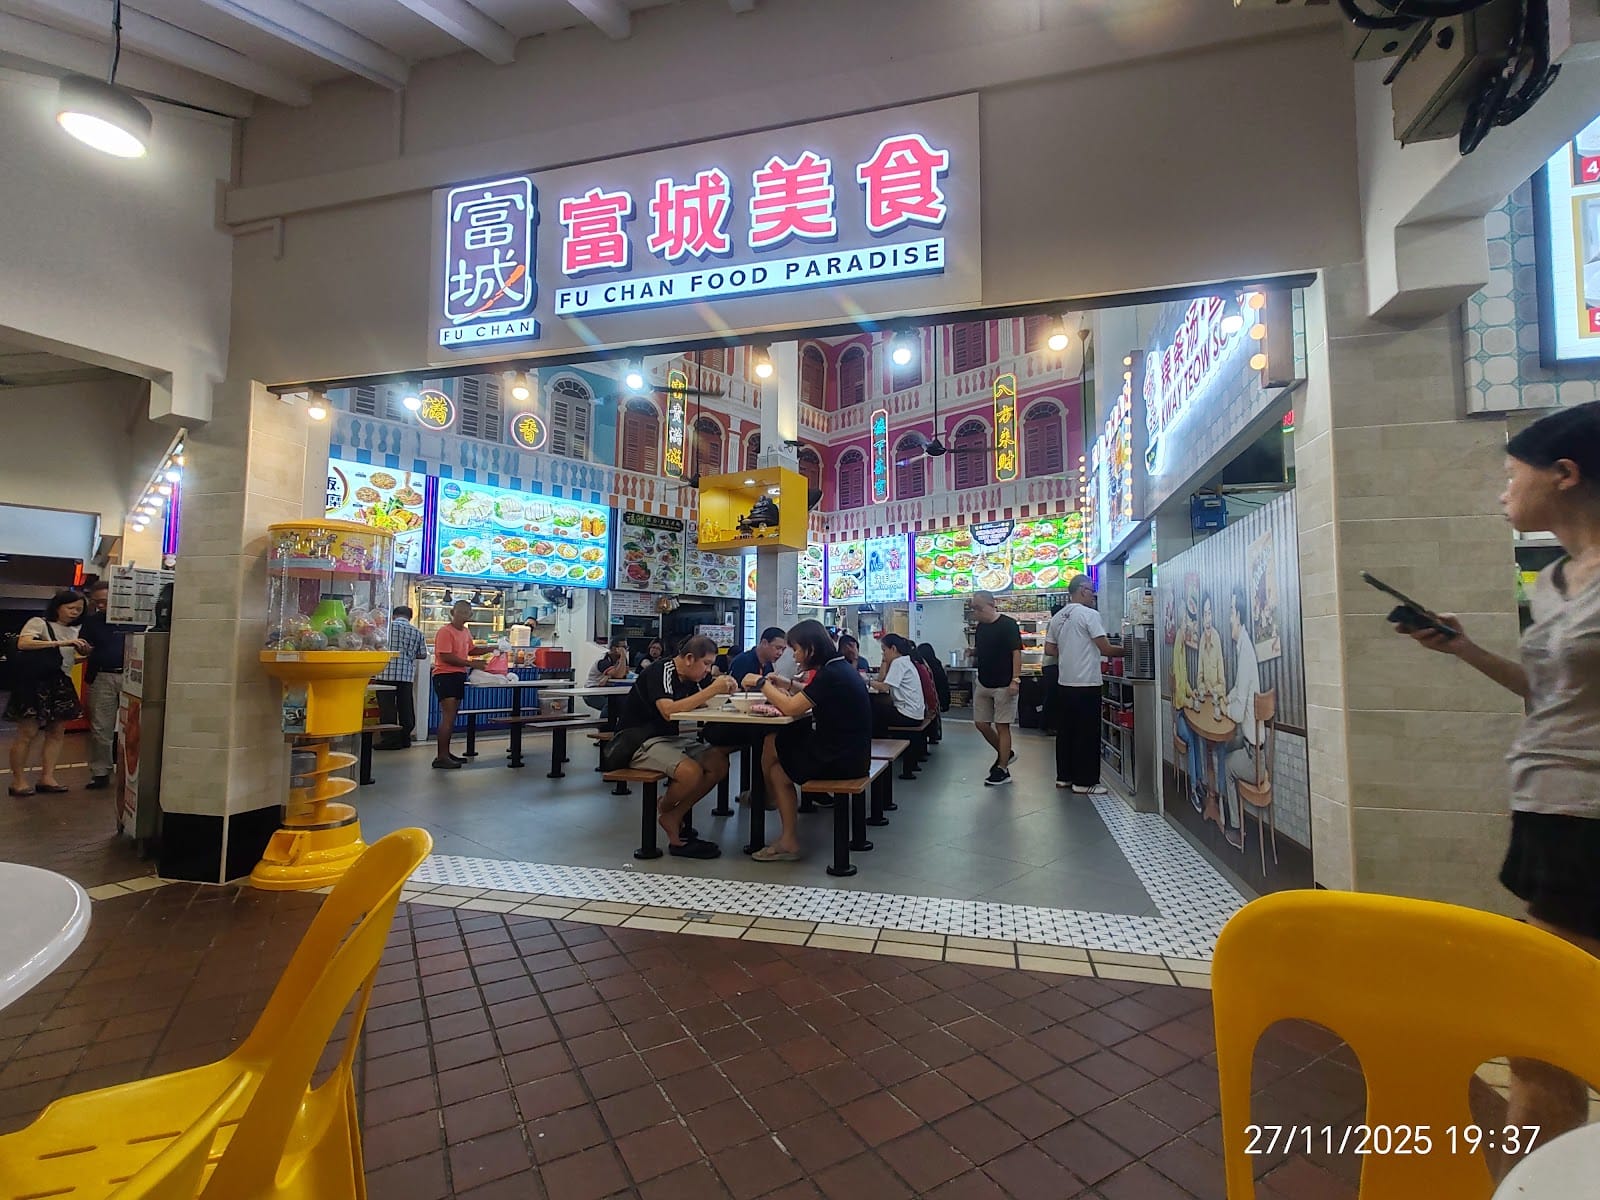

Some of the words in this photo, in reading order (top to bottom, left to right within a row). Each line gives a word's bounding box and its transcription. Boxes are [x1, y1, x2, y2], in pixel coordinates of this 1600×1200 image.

[450, 192, 525, 307] 富城
[560, 134, 948, 275] 富城美食
[560, 288, 589, 309] FU
[604, 278, 674, 304] CHAN
[690, 266, 767, 293] FOOD
[786, 243, 940, 281] PARADISE
[444, 329, 463, 342] FU
[476, 321, 530, 337] CHAN
[1161, 377, 1183, 432] KWAY
[1184, 337, 1210, 399] TEOW
